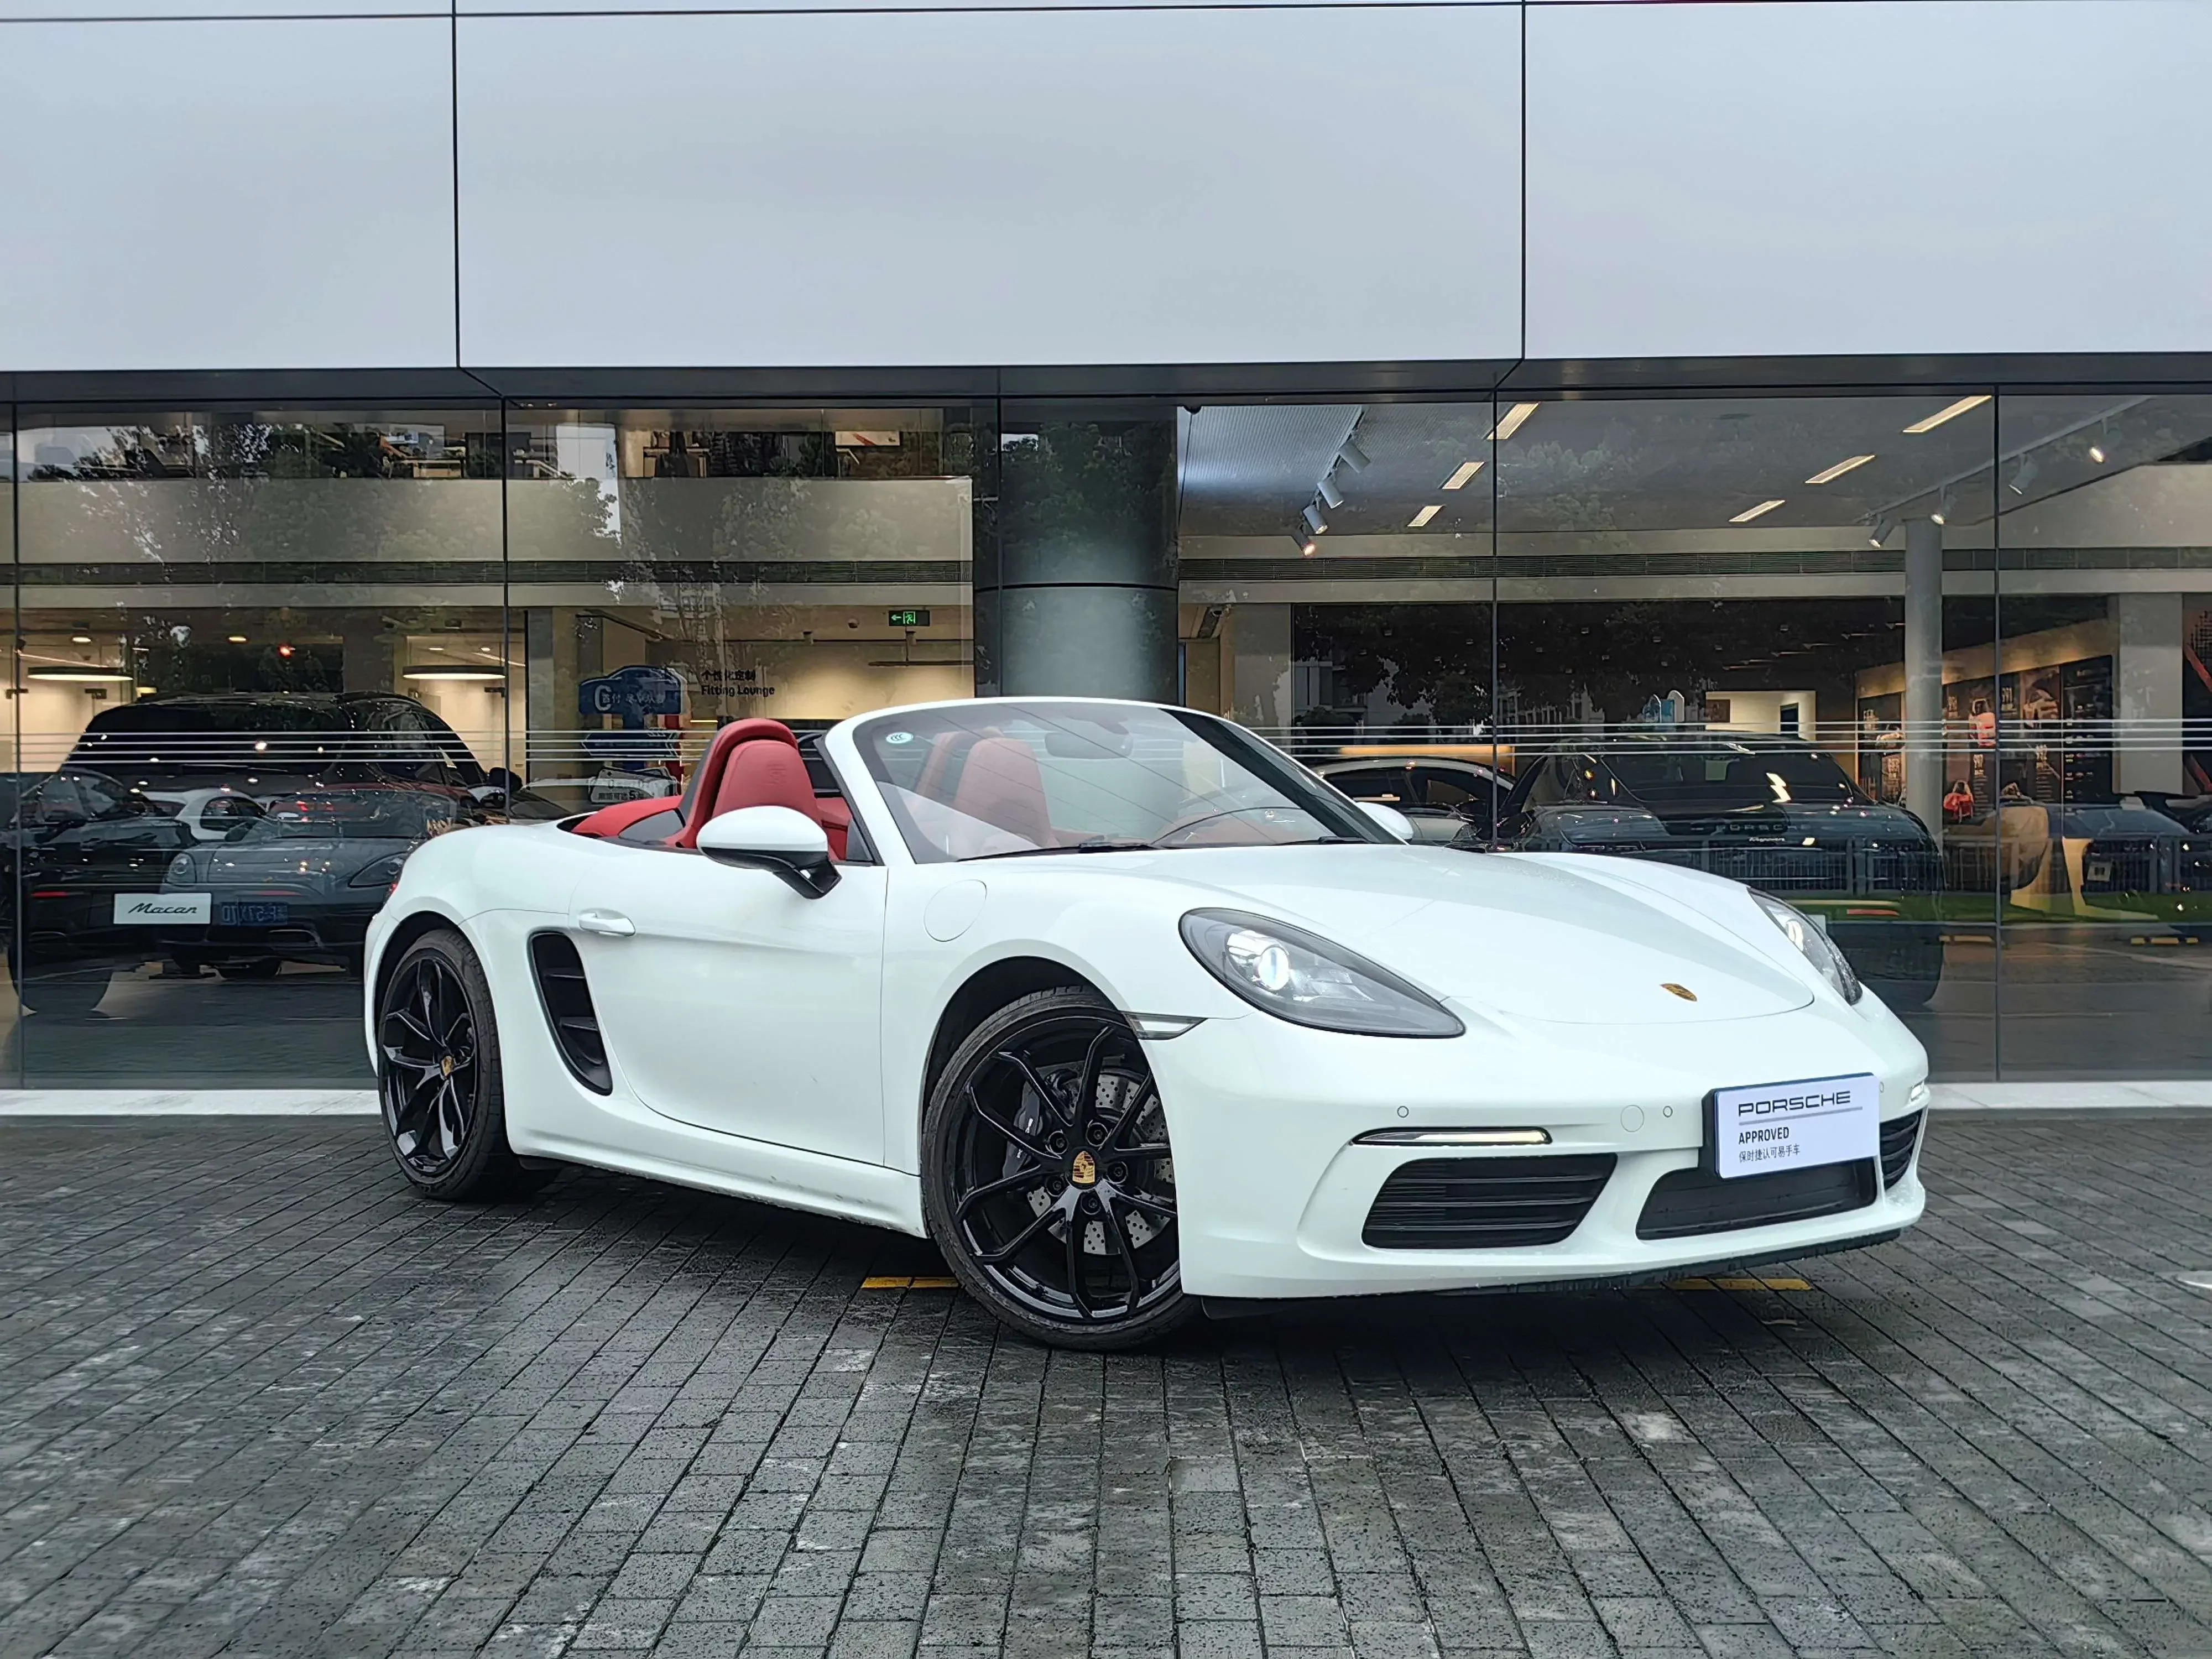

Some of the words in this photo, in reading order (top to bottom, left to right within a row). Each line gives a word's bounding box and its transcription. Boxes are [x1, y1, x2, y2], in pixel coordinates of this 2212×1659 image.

[701, 685, 735, 697] Fitting
[737, 685, 775, 697] Lounge
[128, 902, 197, 914] Macan
[1738, 1091, 1850, 1117] PORSCHE
[1739, 1126, 1790, 1145] APPROVED
[1739, 1143, 1801, 1163] 保时捷认可易手车
